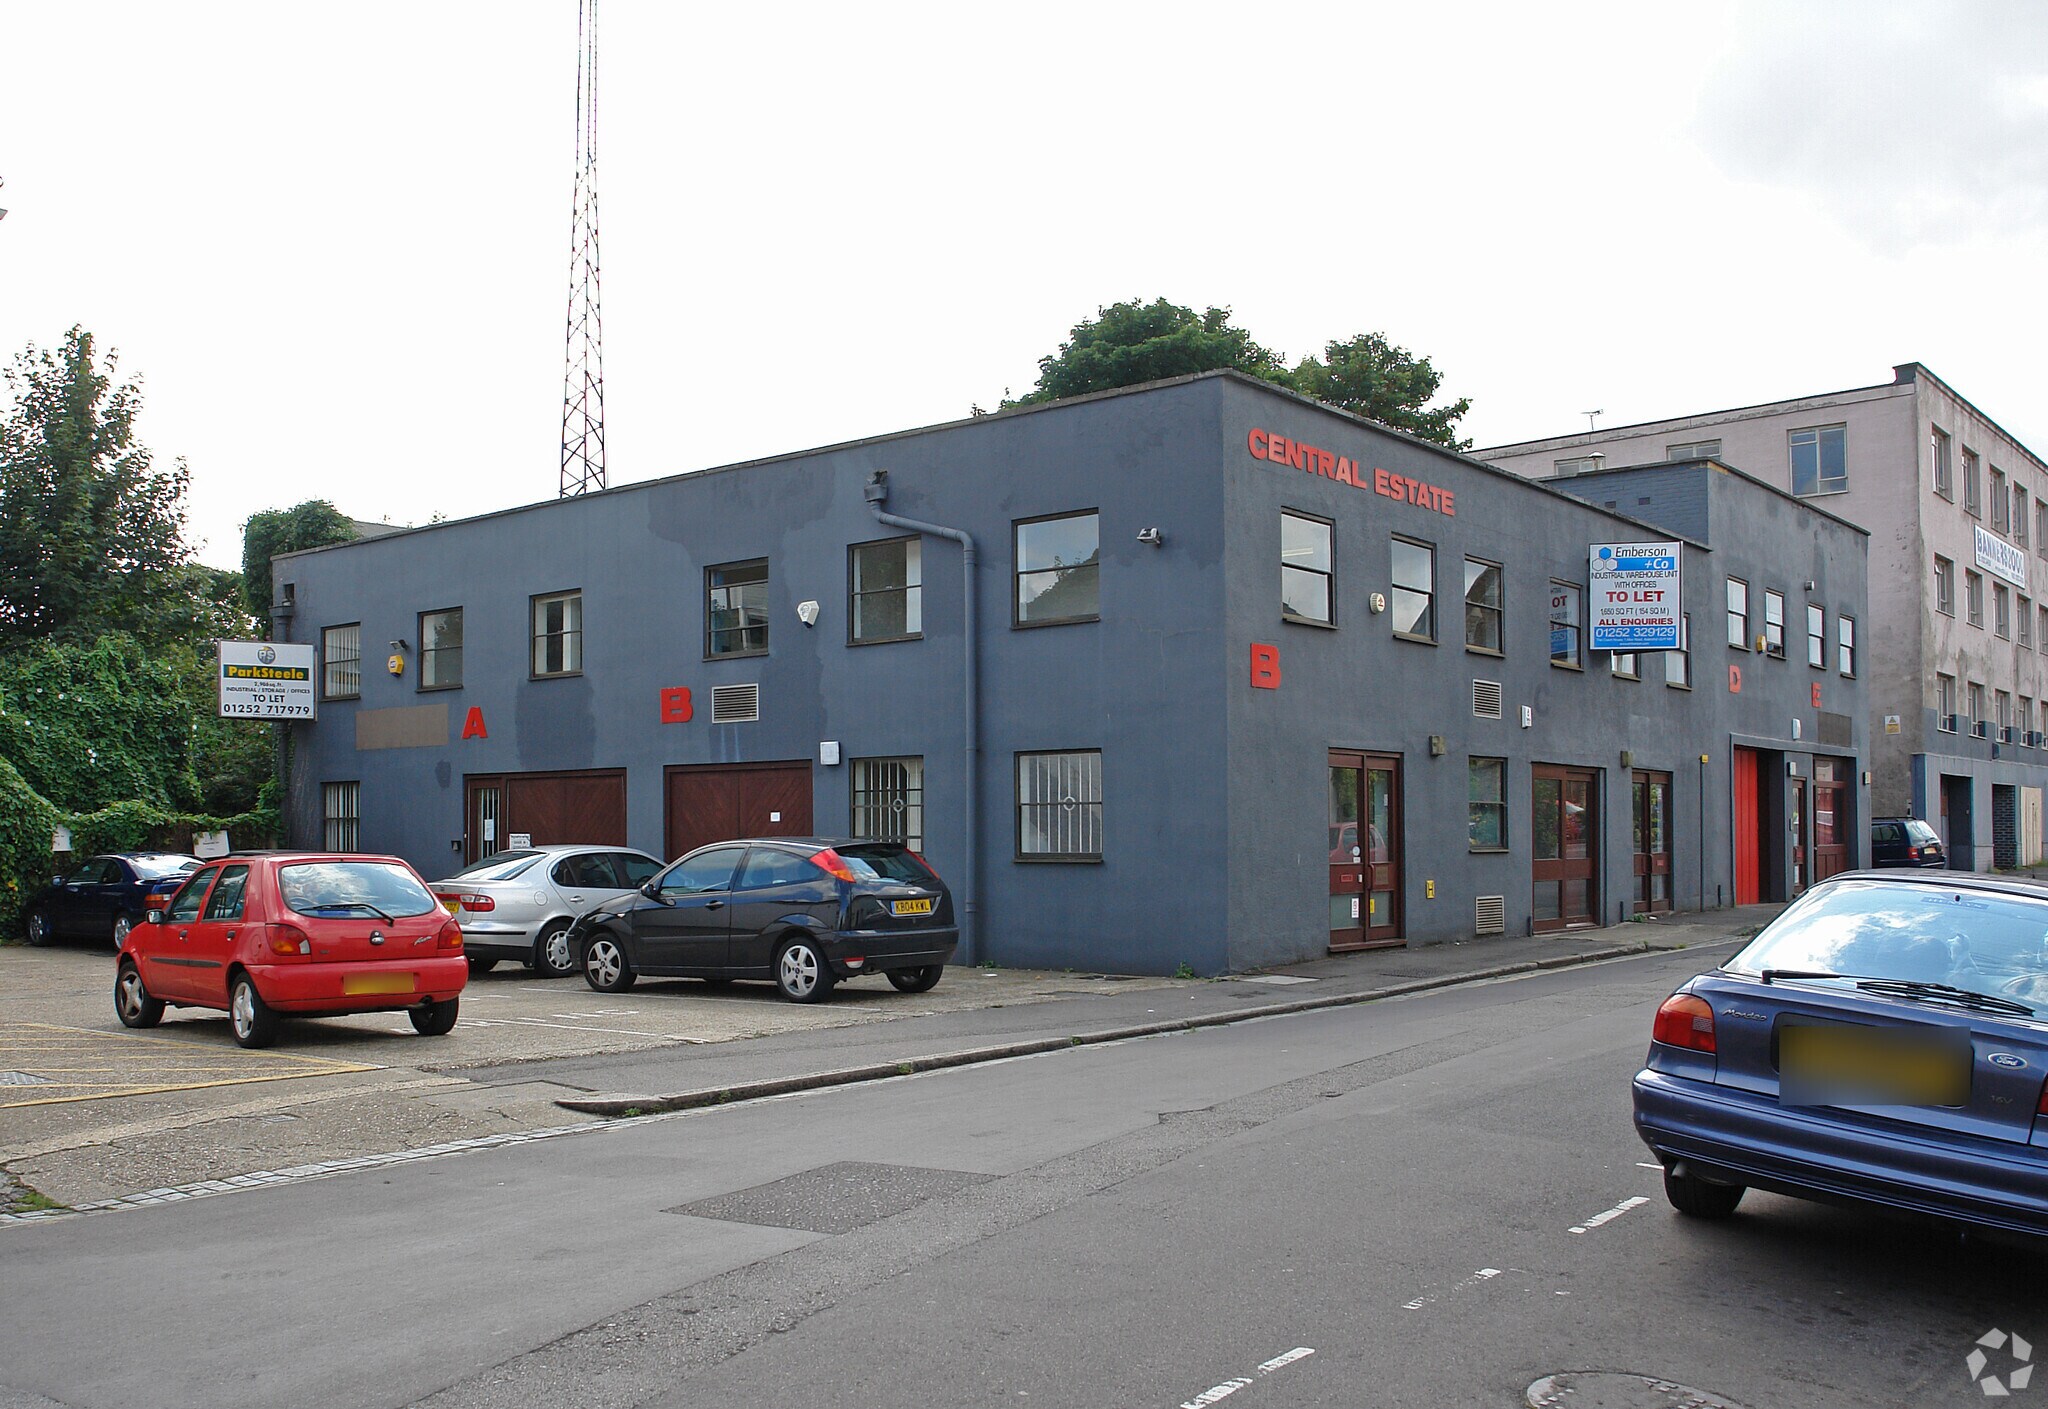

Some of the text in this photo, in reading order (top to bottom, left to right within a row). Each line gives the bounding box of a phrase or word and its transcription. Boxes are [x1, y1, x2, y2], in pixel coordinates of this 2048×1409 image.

[1248, 427, 1456, 516] CENTRAL ESTATE
[1616, 546, 1667, 557] Emberson
[1591, 570, 1678, 580] INDUSTRIAL WAREHOUSE UNIT
[1631, 580, 1657, 588] OFFICES
[1606, 590, 1665, 603] TO LET
[1626, 607, 1634, 615] FT
[1599, 617, 1673, 626] ALL ENQUIRIES
[1595, 627, 1675, 638] 01252 329129
[228, 665, 304, 680] ParkSteele
[1250, 642, 1281, 690] B
[1729, 664, 1741, 694] D
[253, 694, 285, 703] TO LET
[1811, 681, 1822, 708] E
[223, 703, 310, 715] 01252 717979
[660, 686, 694, 724] B
[461, 706, 488, 740] A
[1996, 1054, 2018, 1067] Ford
